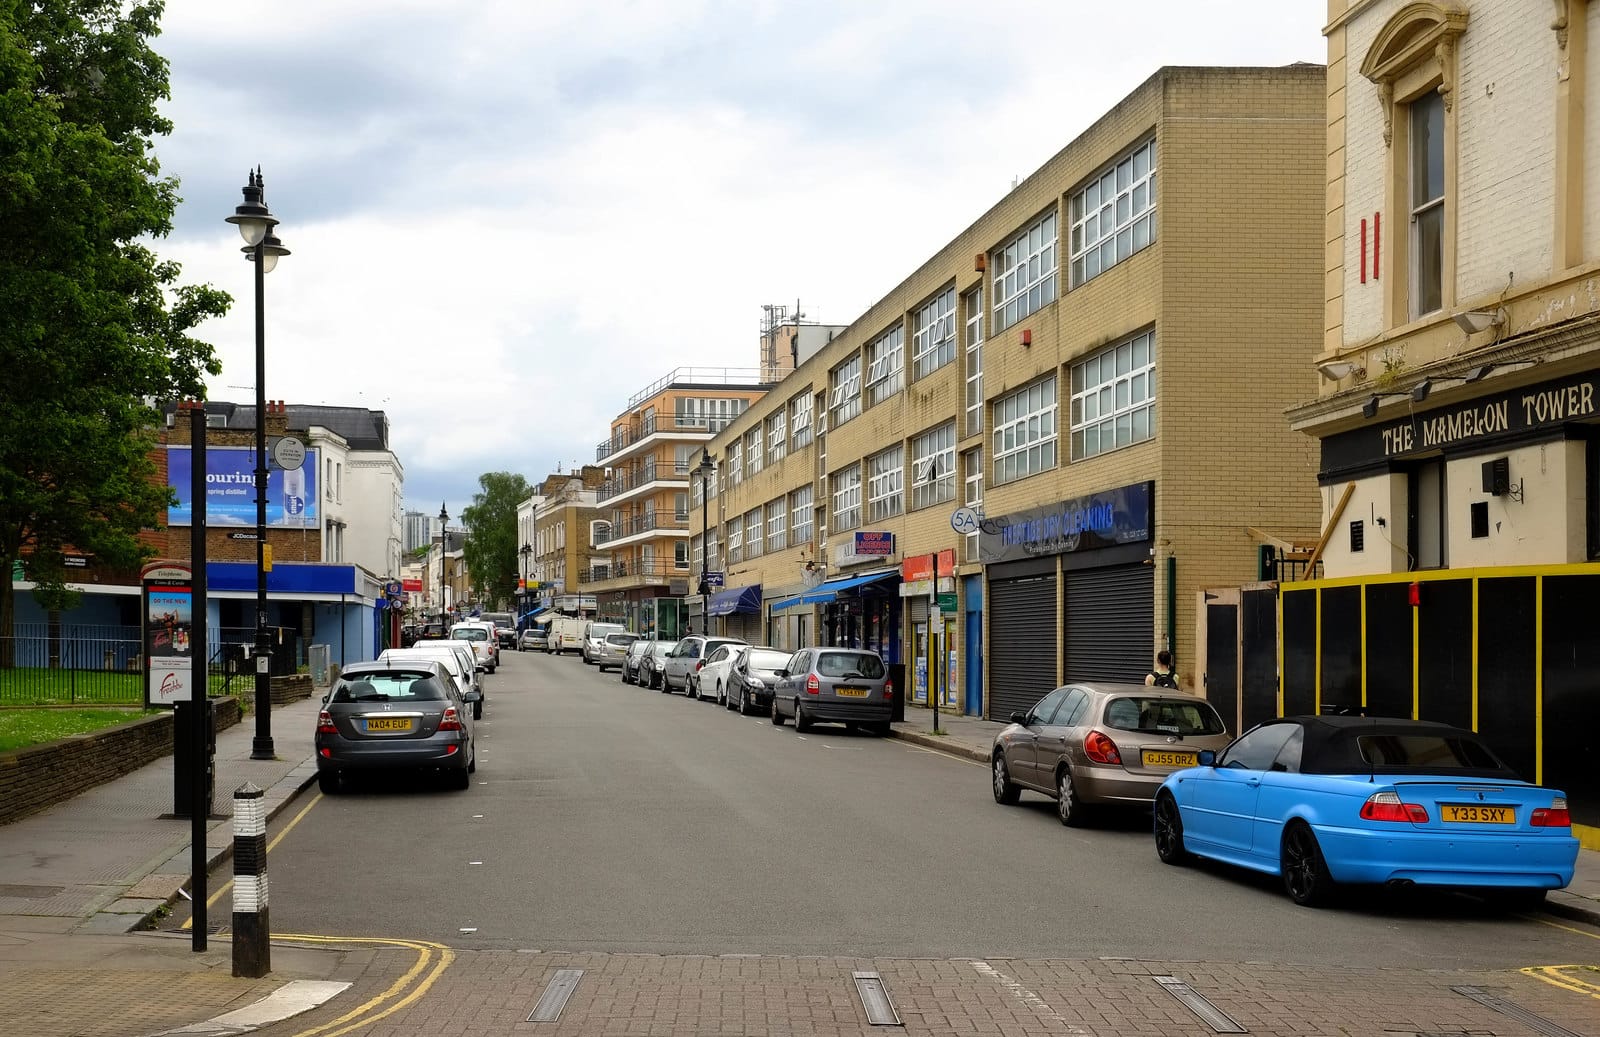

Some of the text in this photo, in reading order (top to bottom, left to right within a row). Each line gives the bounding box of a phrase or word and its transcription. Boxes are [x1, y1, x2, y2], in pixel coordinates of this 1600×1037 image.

[1382, 382, 1594, 455] THE MAMELON TOWER
[955, 512, 975, 527] 5A
[1043, 514, 1060, 539] DRY
[1063, 503, 1113, 535] CLEANING
[863, 532, 883, 541] OFF
[368, 720, 409, 729] NA04 EUF
[1148, 753, 1173, 764] GJ55
[1451, 807, 1506, 822] Y33 SXY
